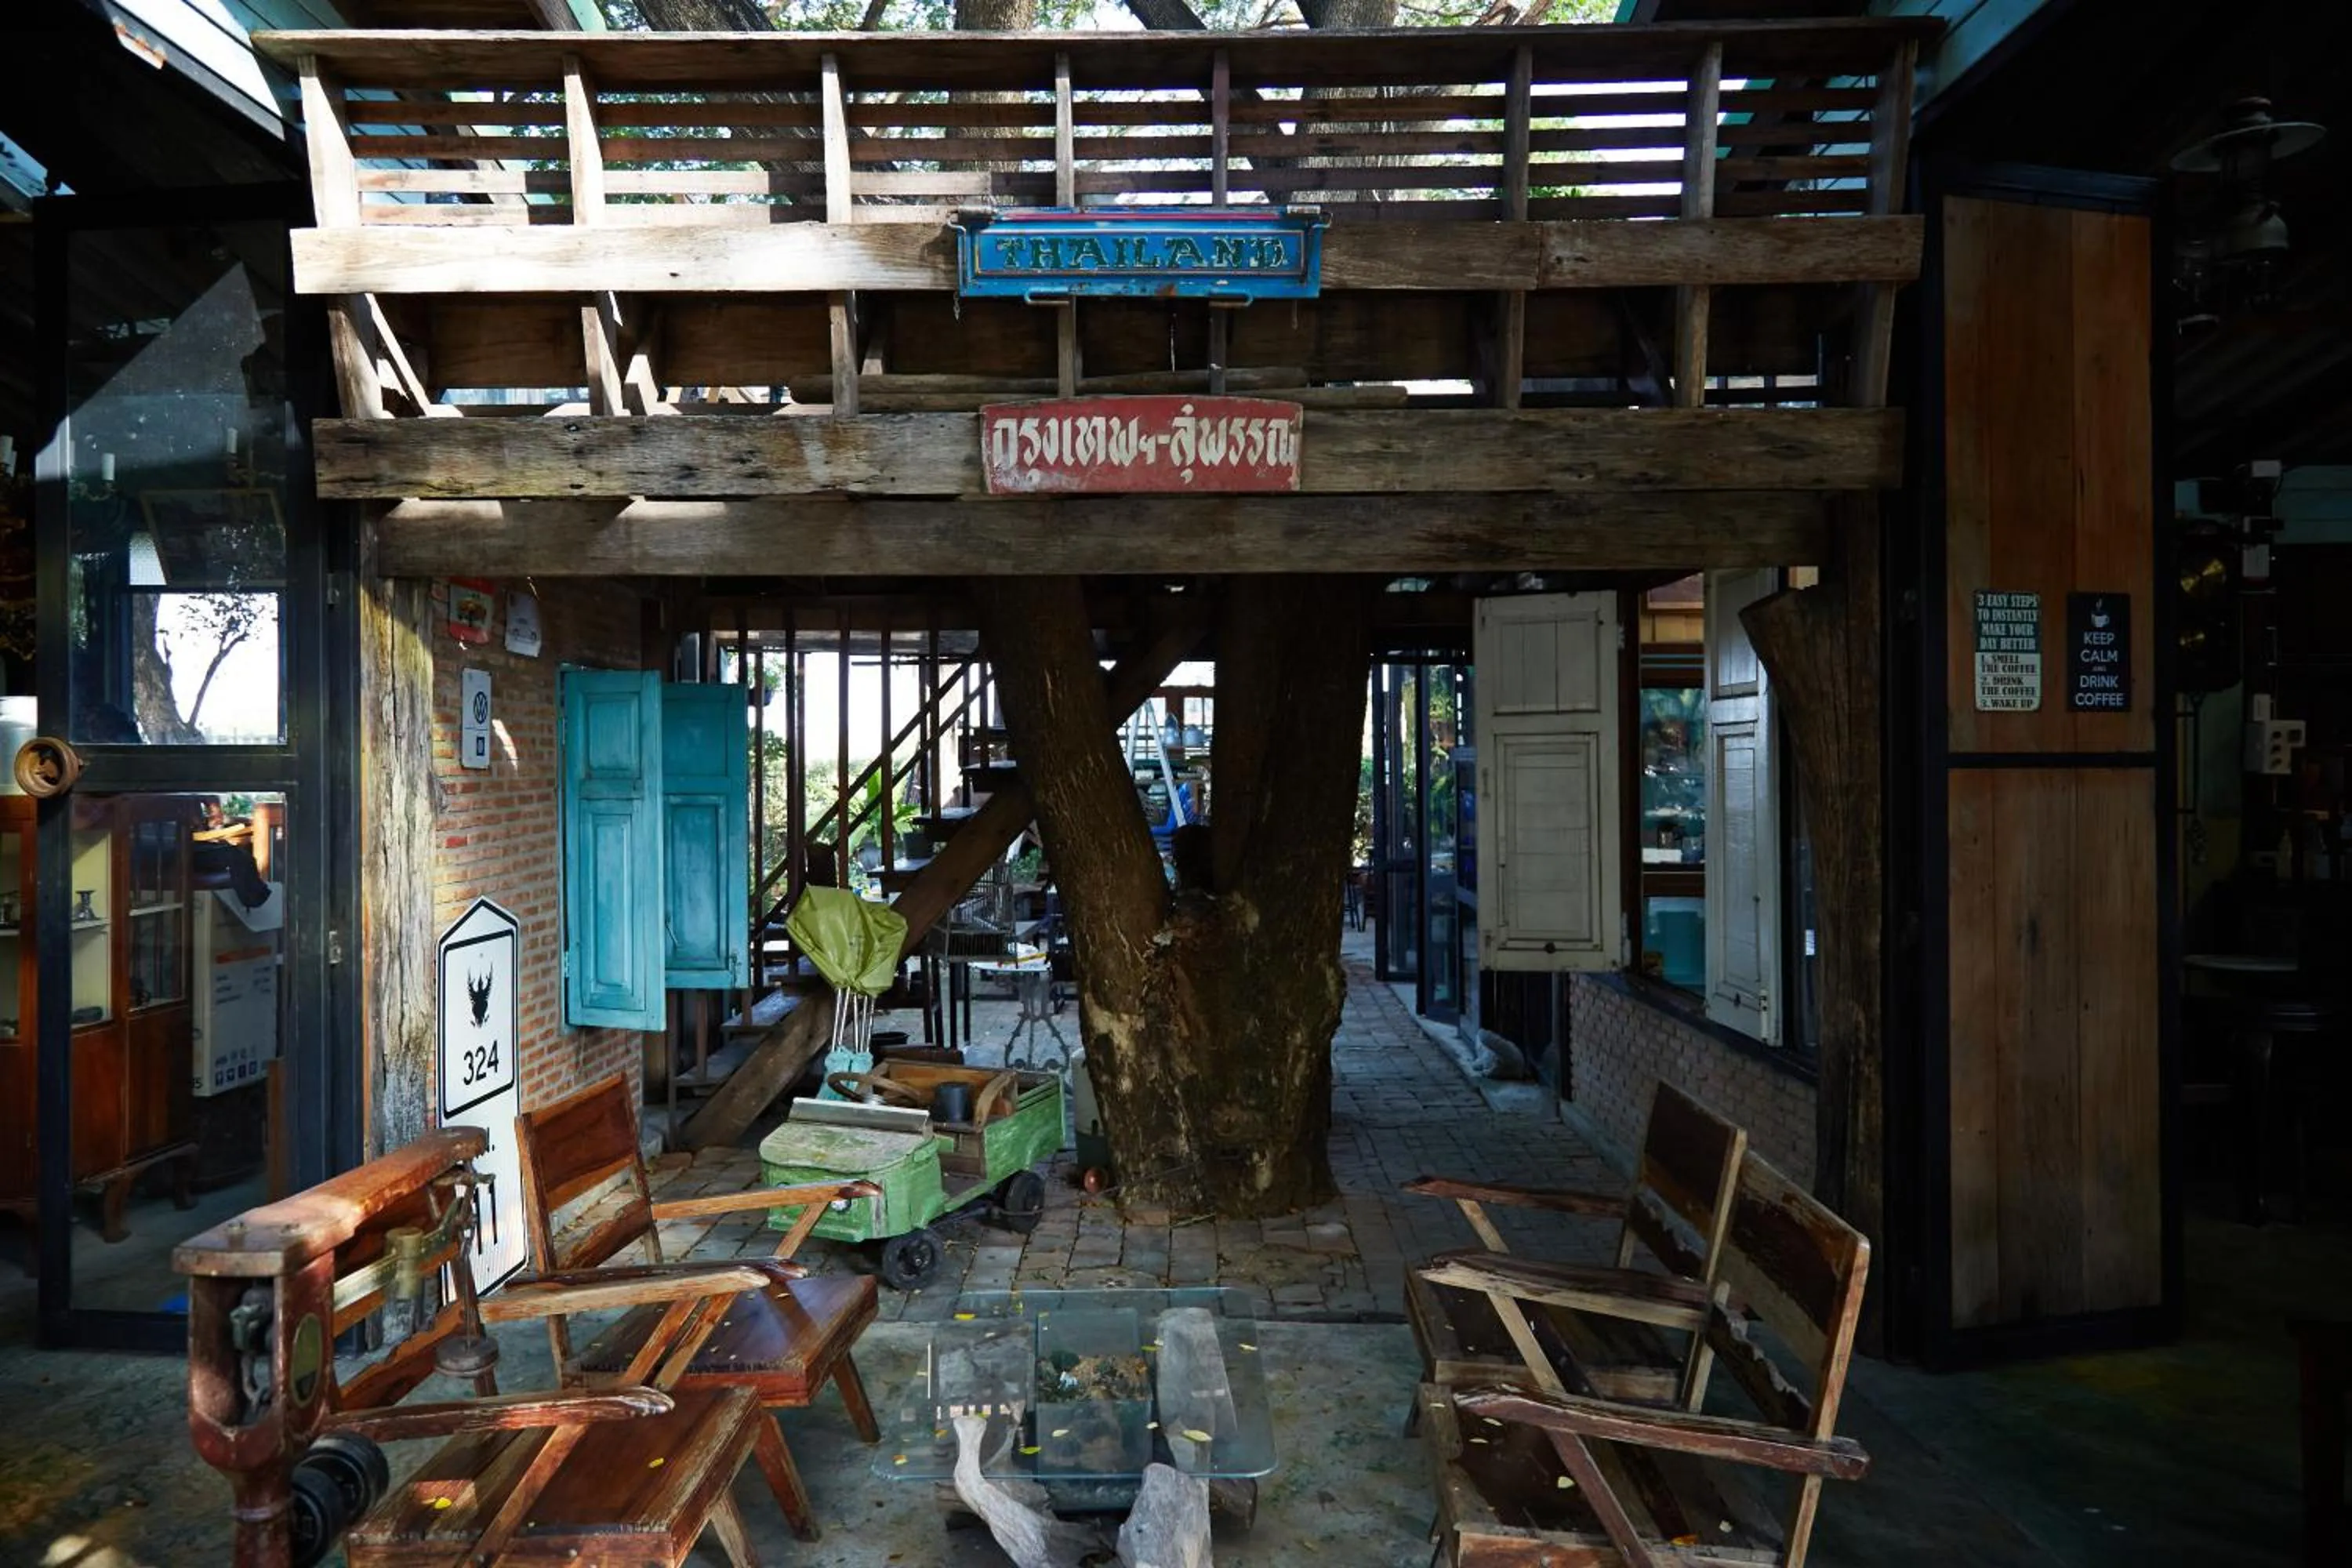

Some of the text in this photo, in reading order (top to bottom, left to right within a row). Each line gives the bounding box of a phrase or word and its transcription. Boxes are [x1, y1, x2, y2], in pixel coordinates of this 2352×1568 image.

[996, 237, 1287, 269] THAILAND
[1978, 594, 2038, 608] 3 EASY STEPS
[1976, 608, 1990, 622] TO
[1981, 622, 2035, 637] MAKE YOUR
[1980, 637, 2036, 651] DAY BETTER
[2083, 631, 2115, 645] KEEP
[1992, 655, 2020, 664] SMELL
[2080, 649, 2119, 662] CALM
[1981, 664, 2035, 673] THE COFFEE
[1992, 677, 2024, 686] DRINK
[2080, 675, 2119, 688] DRINK
[1981, 686, 2035, 695] THE COFFEE
[1991, 699, 2018, 708] WAKE
[2020, 699, 2034, 708] UP
[2075, 692, 2125, 706] COFFEE
[463, 1040, 499, 1086] 324
